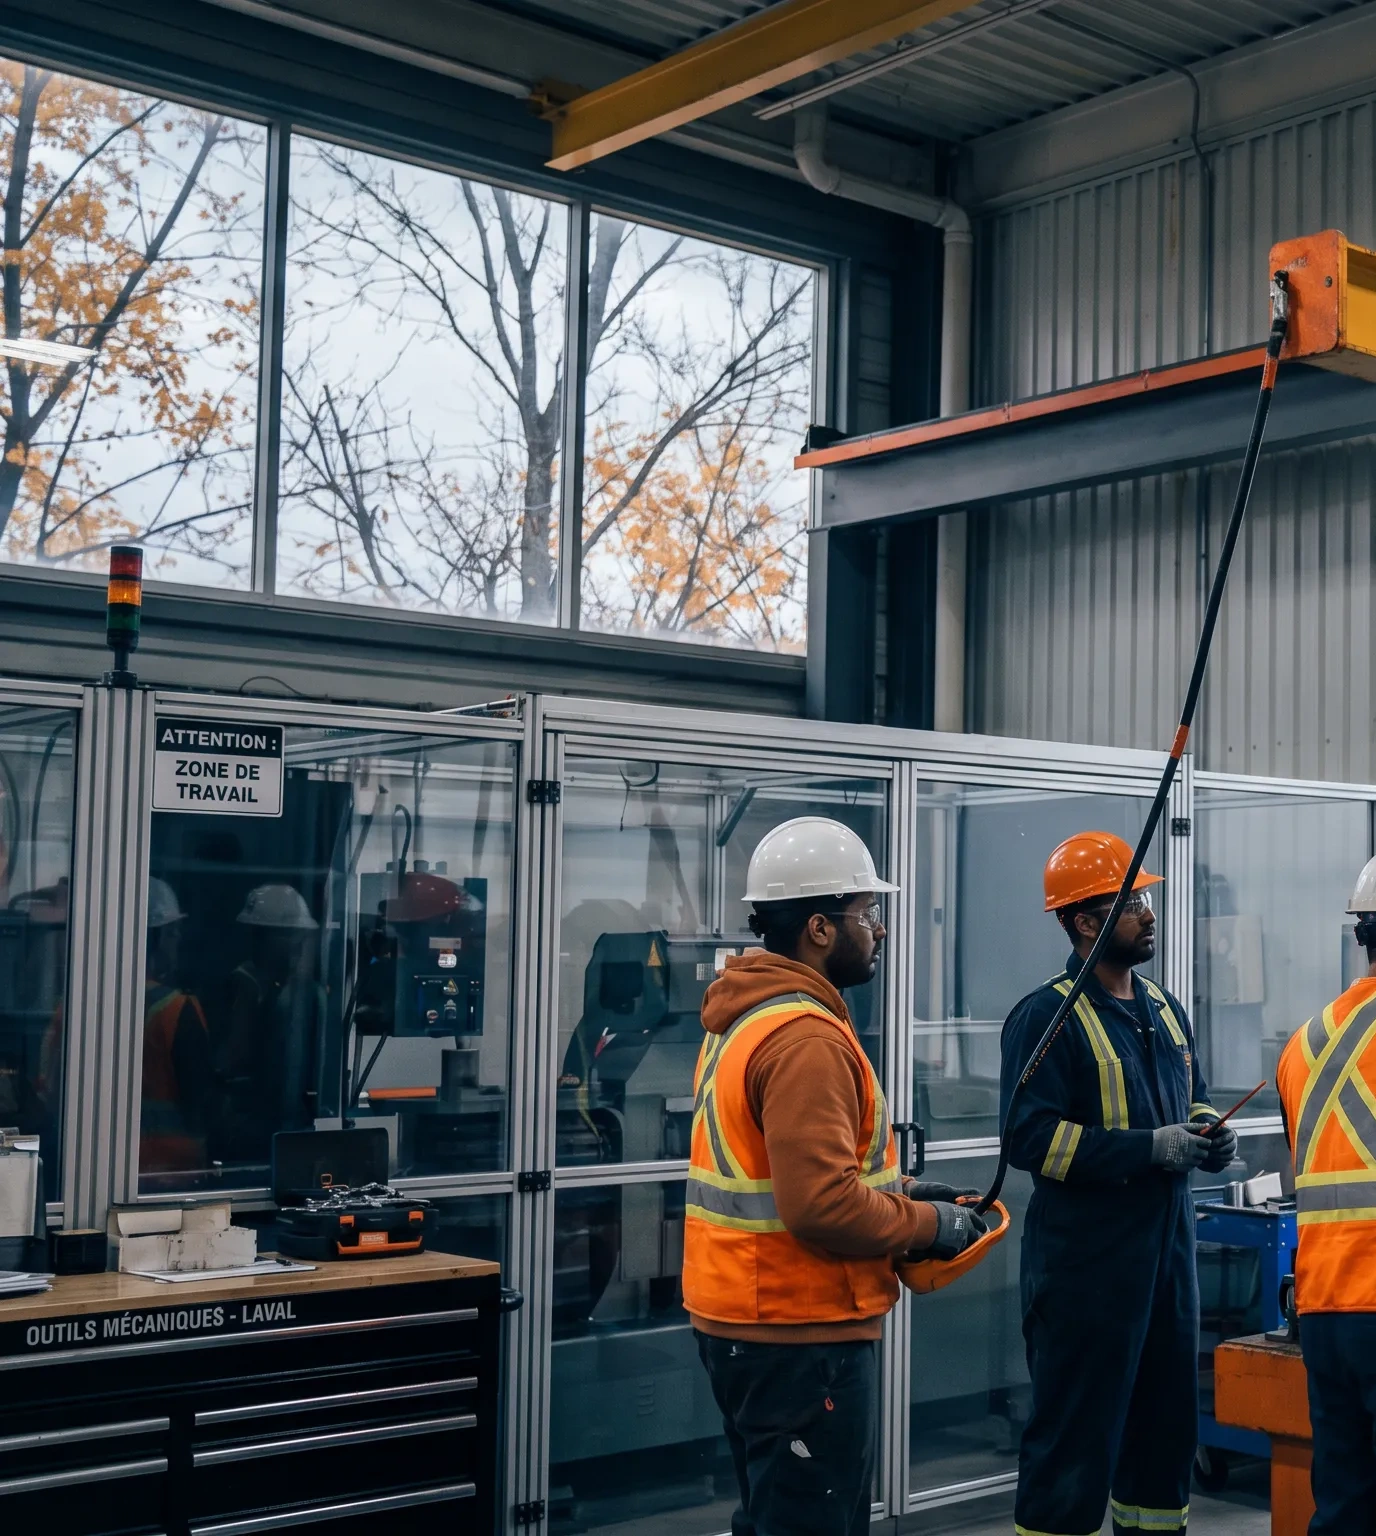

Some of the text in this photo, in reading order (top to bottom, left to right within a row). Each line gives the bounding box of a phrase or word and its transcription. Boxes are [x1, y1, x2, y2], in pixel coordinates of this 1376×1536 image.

[161, 728, 266, 750] ATTENTION
[175, 760, 260, 780] ZONE DE
[176, 783, 258, 803] TRAVAIL
[26, 1319, 97, 1346] OUTILS
[103, 1306, 224, 1338] MÉCANIQUES
[242, 1301, 296, 1324] LAVAL
